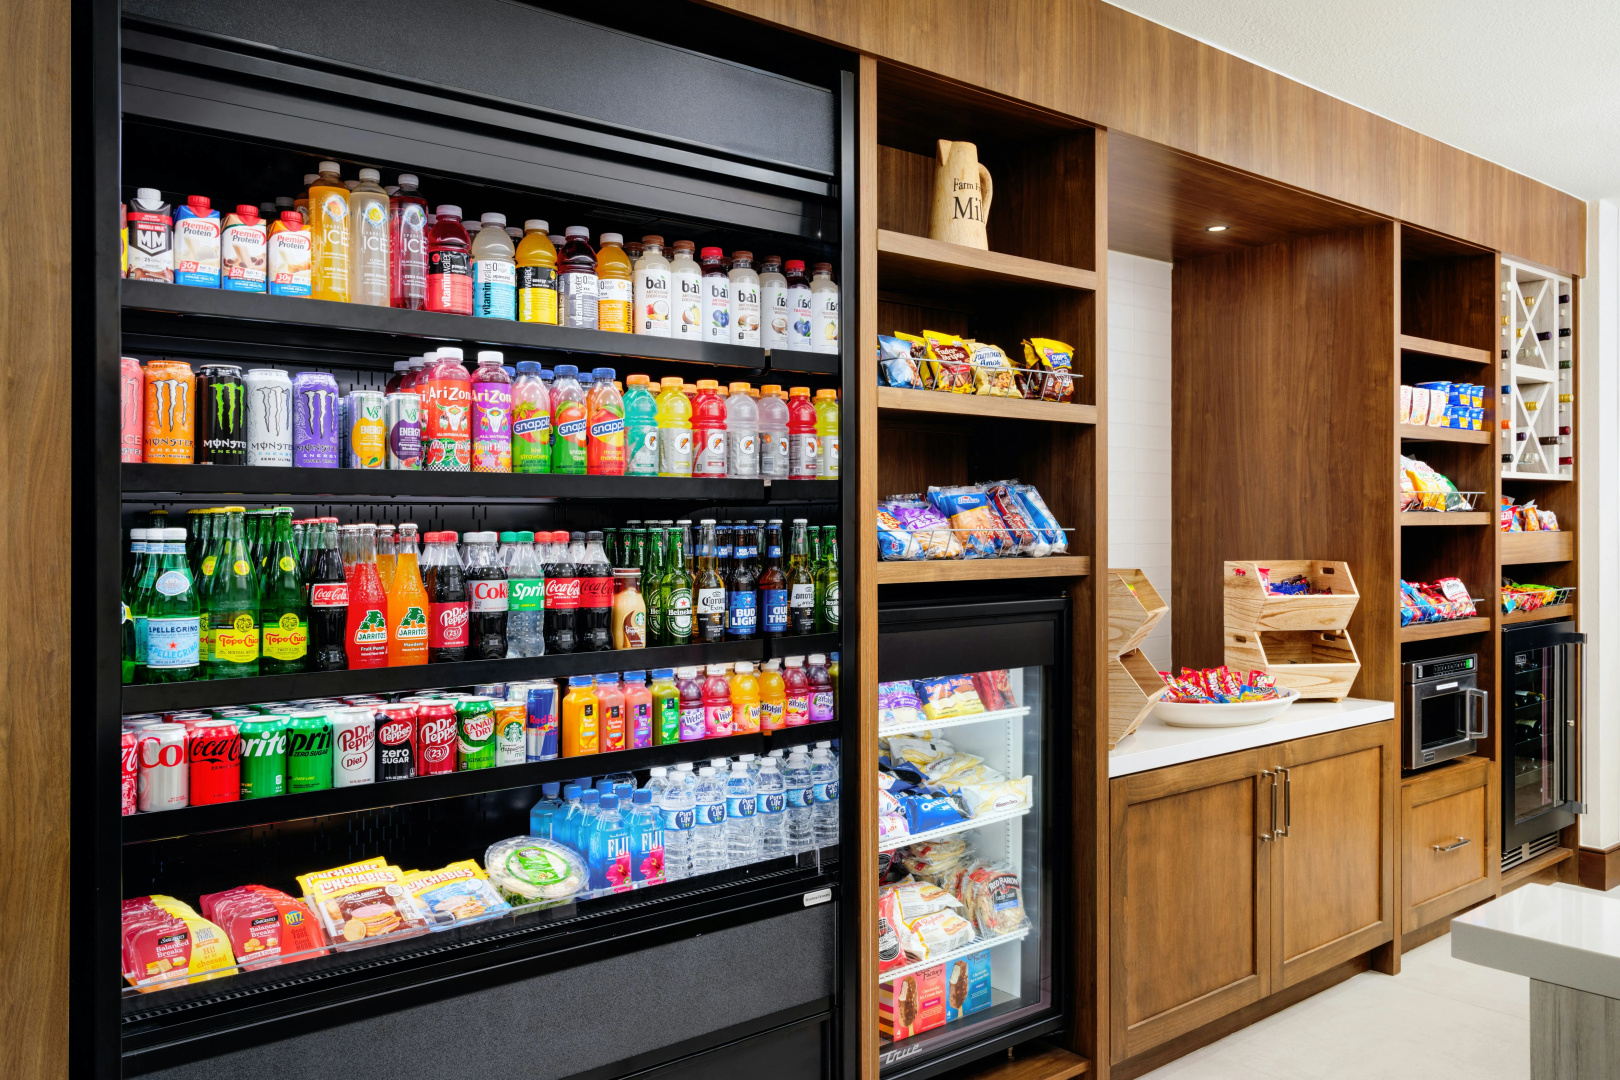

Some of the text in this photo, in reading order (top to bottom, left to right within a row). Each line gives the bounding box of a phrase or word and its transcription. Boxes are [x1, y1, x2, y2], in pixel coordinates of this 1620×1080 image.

[953, 177, 974, 192] Farm
[182, 221, 214, 232] Premier
[184, 227, 212, 238] Protein
[230, 229, 262, 240] Premier
[232, 234, 260, 244] Protein
[277, 234, 307, 245] Premier
[324, 228, 350, 246] ICE
[278, 240, 304, 250] Protein
[363, 236, 388, 253] ICE
[403, 238, 428, 254] ICE
[182, 261, 197, 270] 30g
[230, 268, 244, 276] 30g
[484, 261, 492, 316] vitaminwater
[646, 275, 666, 290] bai
[682, 280, 700, 294] bai
[712, 284, 728, 298] bai
[738, 289, 757, 304] bai
[934, 348, 957, 356] Fudge
[942, 352, 965, 362] Stripes
[973, 350, 1002, 362] Famous
[980, 358, 1002, 367] Amos
[428, 386, 471, 402] AriZon
[472, 389, 512, 404] AriZon
[366, 406, 381, 420] V8
[405, 408, 420, 422] V8
[360, 426, 383, 435] ENERGY
[400, 428, 420, 437] ENERGY
[560, 420, 586, 434] snapp
[593, 418, 624, 434] snappl
[145, 438, 195, 450] MONSTER
[203, 438, 246, 450] MONSTE
[252, 442, 292, 451] MONSTE
[644, 432, 658, 451] G
[674, 432, 690, 454] G
[708, 433, 724, 454] G
[740, 436, 755, 455] G
[296, 443, 338, 454] MONSTE
[512, 582, 544, 600] Sprit
[546, 580, 580, 596] Coca-Col
[580, 579, 614, 596] Coca-Co
[314, 588, 348, 601] Coca-Cola
[702, 596, 726, 608] Coron
[444, 609, 468, 626] Pepper
[452, 608, 464, 617] Dr
[736, 608, 756, 617] BUD
[358, 632, 386, 641] JARRITOS
[398, 628, 427, 636] JARRITOS
[219, 634, 242, 648] Topo
[266, 632, 307, 646] Topo Chico
[436, 718, 452, 731] Dr
[464, 714, 496, 735] CANAD
[529, 714, 558, 724] Red Bu
[354, 724, 370, 736] Dr
[390, 722, 403, 732] Dr
[426, 722, 458, 745] Pepper
[475, 726, 492, 738] DRY
[286, 724, 330, 757] Spri
[343, 727, 375, 752] Pepper
[382, 726, 411, 743] Pepper
[138, 735, 188, 770] Co
[190, 733, 241, 764] Coca-C
[382, 748, 410, 758] zero
[431, 750, 442, 758] 23
[346, 755, 363, 768] Diet
[680, 816, 692, 824] Life
[608, 836, 630, 858] FIJI
[641, 830, 664, 852] FIJI
[320, 872, 397, 896] LUNCHABLES
[988, 876, 1019, 890] RED BARON
[252, 916, 276, 926] Sargento
[285, 912, 304, 926] RITZ
[194, 928, 212, 936] WHEAT
[249, 922, 281, 932] Balanced
[250, 928, 275, 938] Breaks
[160, 934, 186, 944] Sargento
[196, 934, 214, 943] THINS
[156, 940, 190, 953] Balanced
[156, 948, 183, 958] Breaks
[203, 946, 216, 955] Hi!
[196, 954, 227, 969] cheesed
[922, 968, 943, 981] Factory
[922, 985, 940, 994] Cheesecake
